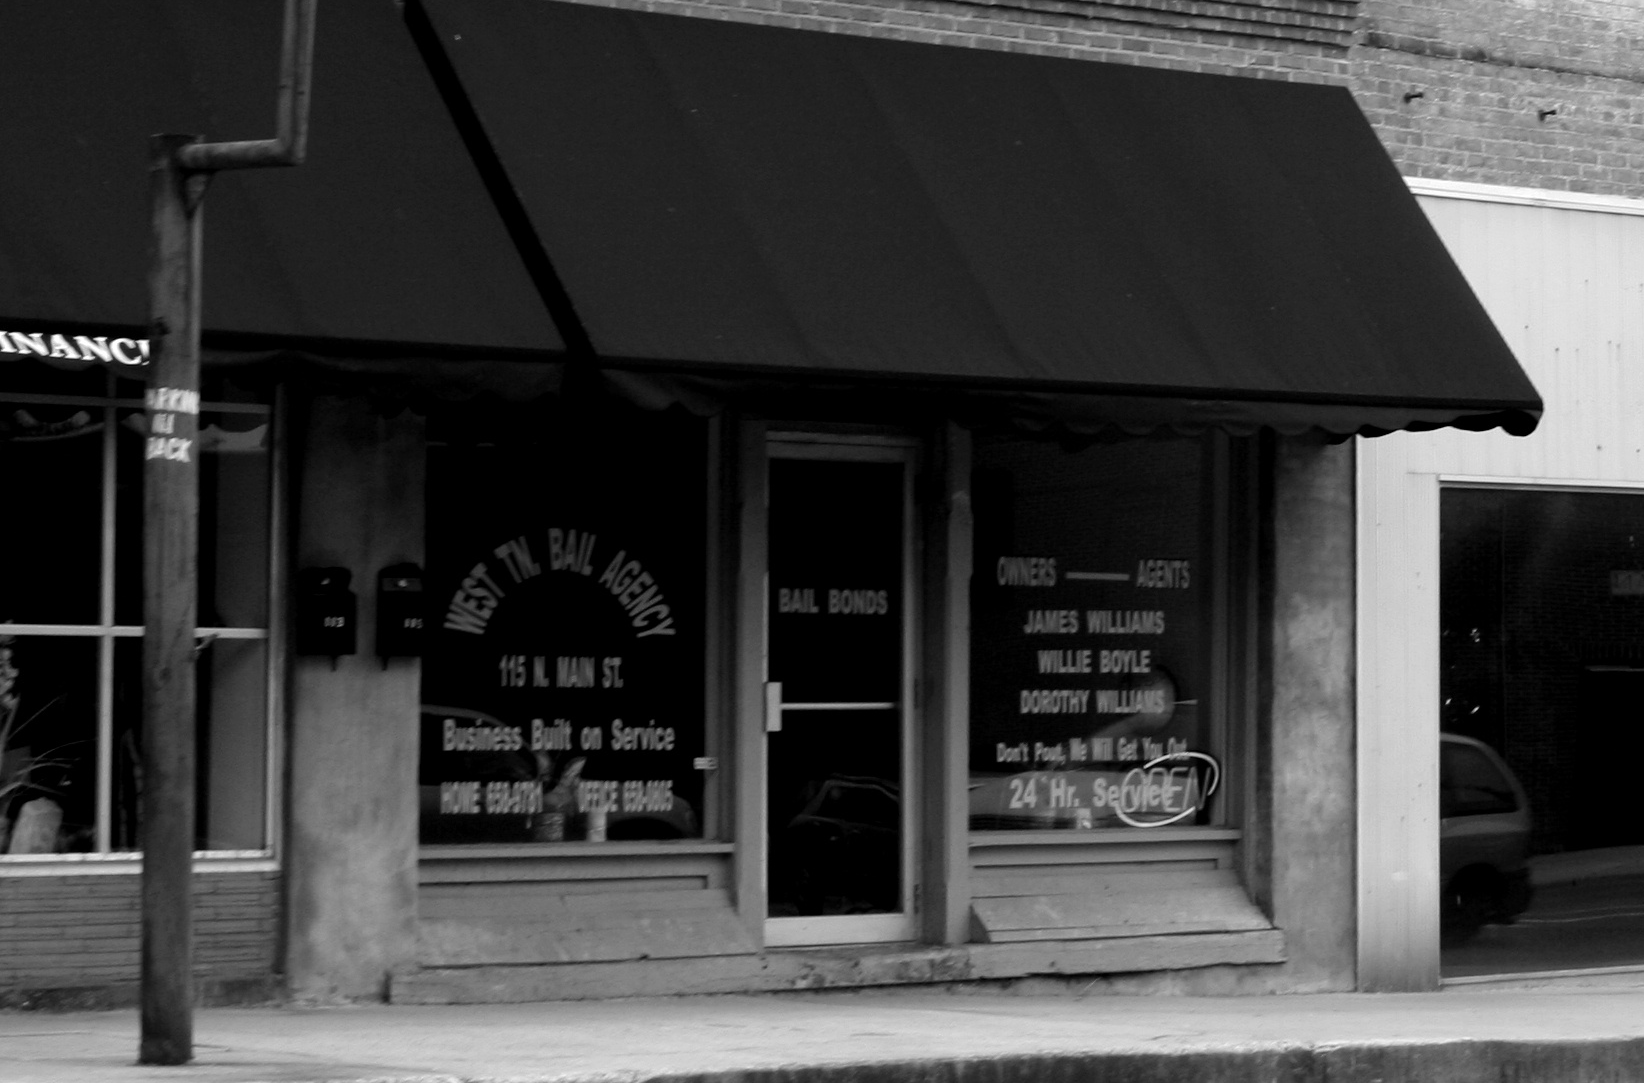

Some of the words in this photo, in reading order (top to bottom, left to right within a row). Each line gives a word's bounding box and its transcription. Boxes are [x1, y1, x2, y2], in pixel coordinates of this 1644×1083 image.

[0, 330, 150, 367] INANC
[443, 562, 505, 634] WEST
[548, 528, 596, 576] BAIL
[599, 550, 676, 637] AGENCY
[997, 556, 1056, 587] OWNERS
[1136, 559, 1191, 588] AGENTS
[778, 588, 819, 613] BAIL
[828, 589, 888, 614] BONDS
[1024, 610, 1079, 633] JAMES
[1087, 610, 1165, 634] WILLIAMS
[500, 655, 526, 686] 115
[556, 656, 595, 688] MAIN
[1037, 650, 1092, 673] WILLIE
[1100, 650, 1151, 673] BOYLE
[1020, 689, 1090, 714] DOROTHY
[1096, 689, 1165, 713] WILLIAMS
[443, 719, 522, 751] Business
[531, 719, 572, 751] Built
[580, 726, 602, 750] on
[611, 719, 675, 750] Service
[1117, 737, 1138, 761] Get
[1009, 779, 1037, 808] 24
[1049, 778, 1080, 807] Hr.
